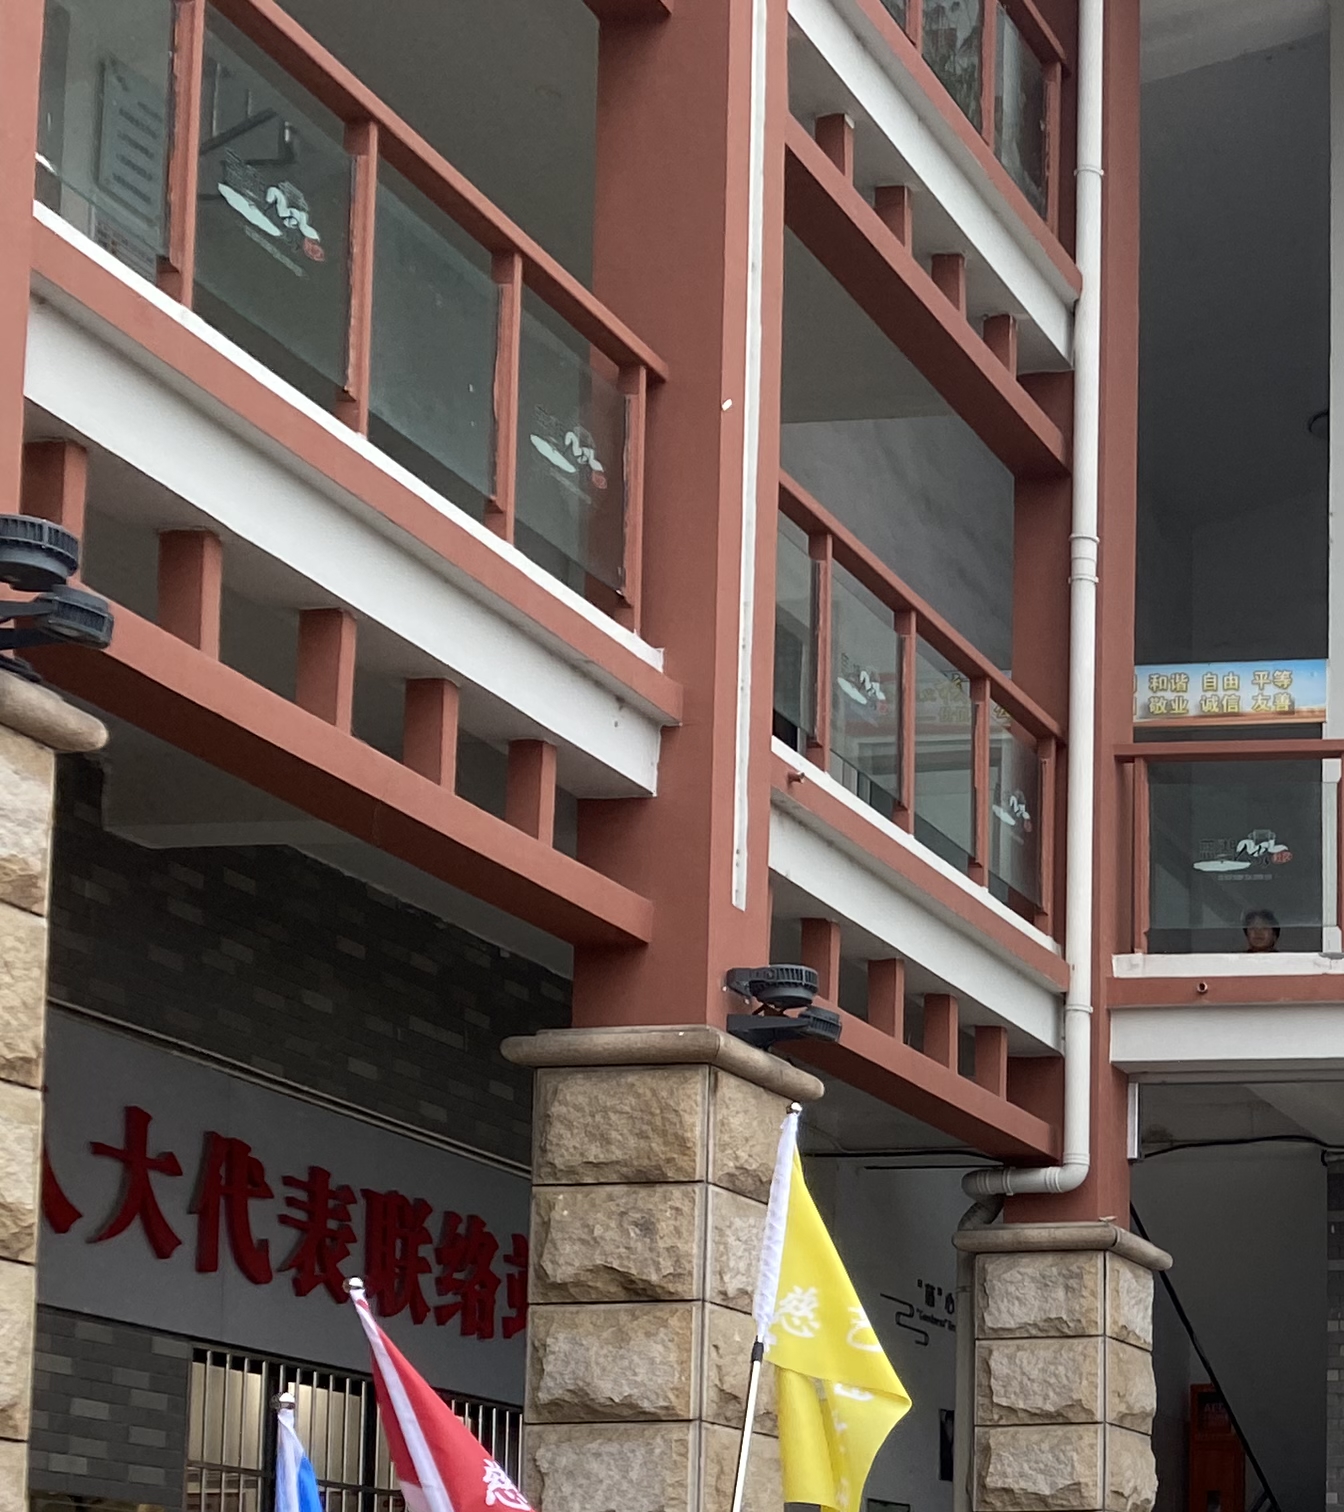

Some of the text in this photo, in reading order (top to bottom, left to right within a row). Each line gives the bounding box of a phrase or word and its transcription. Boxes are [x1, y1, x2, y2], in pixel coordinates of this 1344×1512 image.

[1149, 669, 1293, 692] 和谐 自由 平等
[1149, 692, 1293, 714] 敬业 诚信 友善
